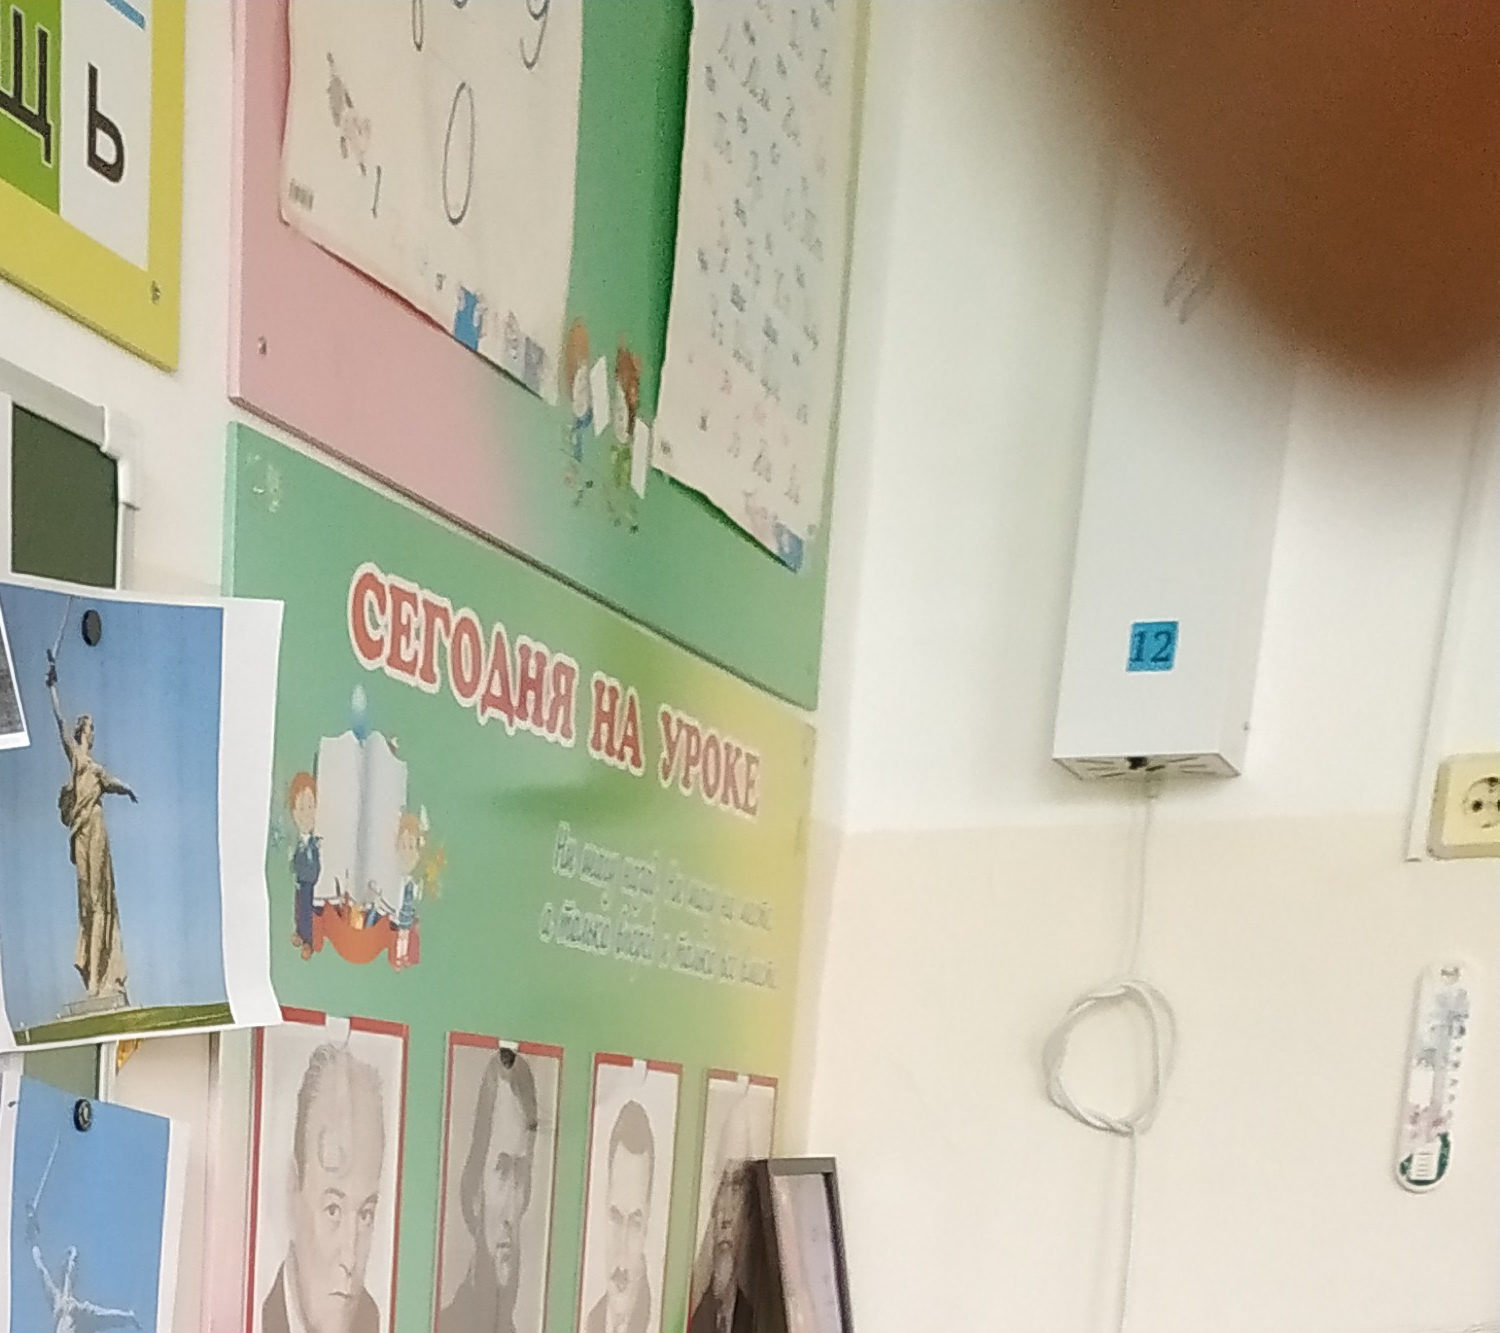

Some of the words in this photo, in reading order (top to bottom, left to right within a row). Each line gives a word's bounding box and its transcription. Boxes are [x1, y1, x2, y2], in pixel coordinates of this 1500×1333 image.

[87, 61, 124, 184] Ь
[348, 564, 578, 744] СЕГОДНЯ
[590, 674, 644, 773] НА
[659, 706, 761, 816] УРОКЕ
[1129, 629, 1175, 664] 12
